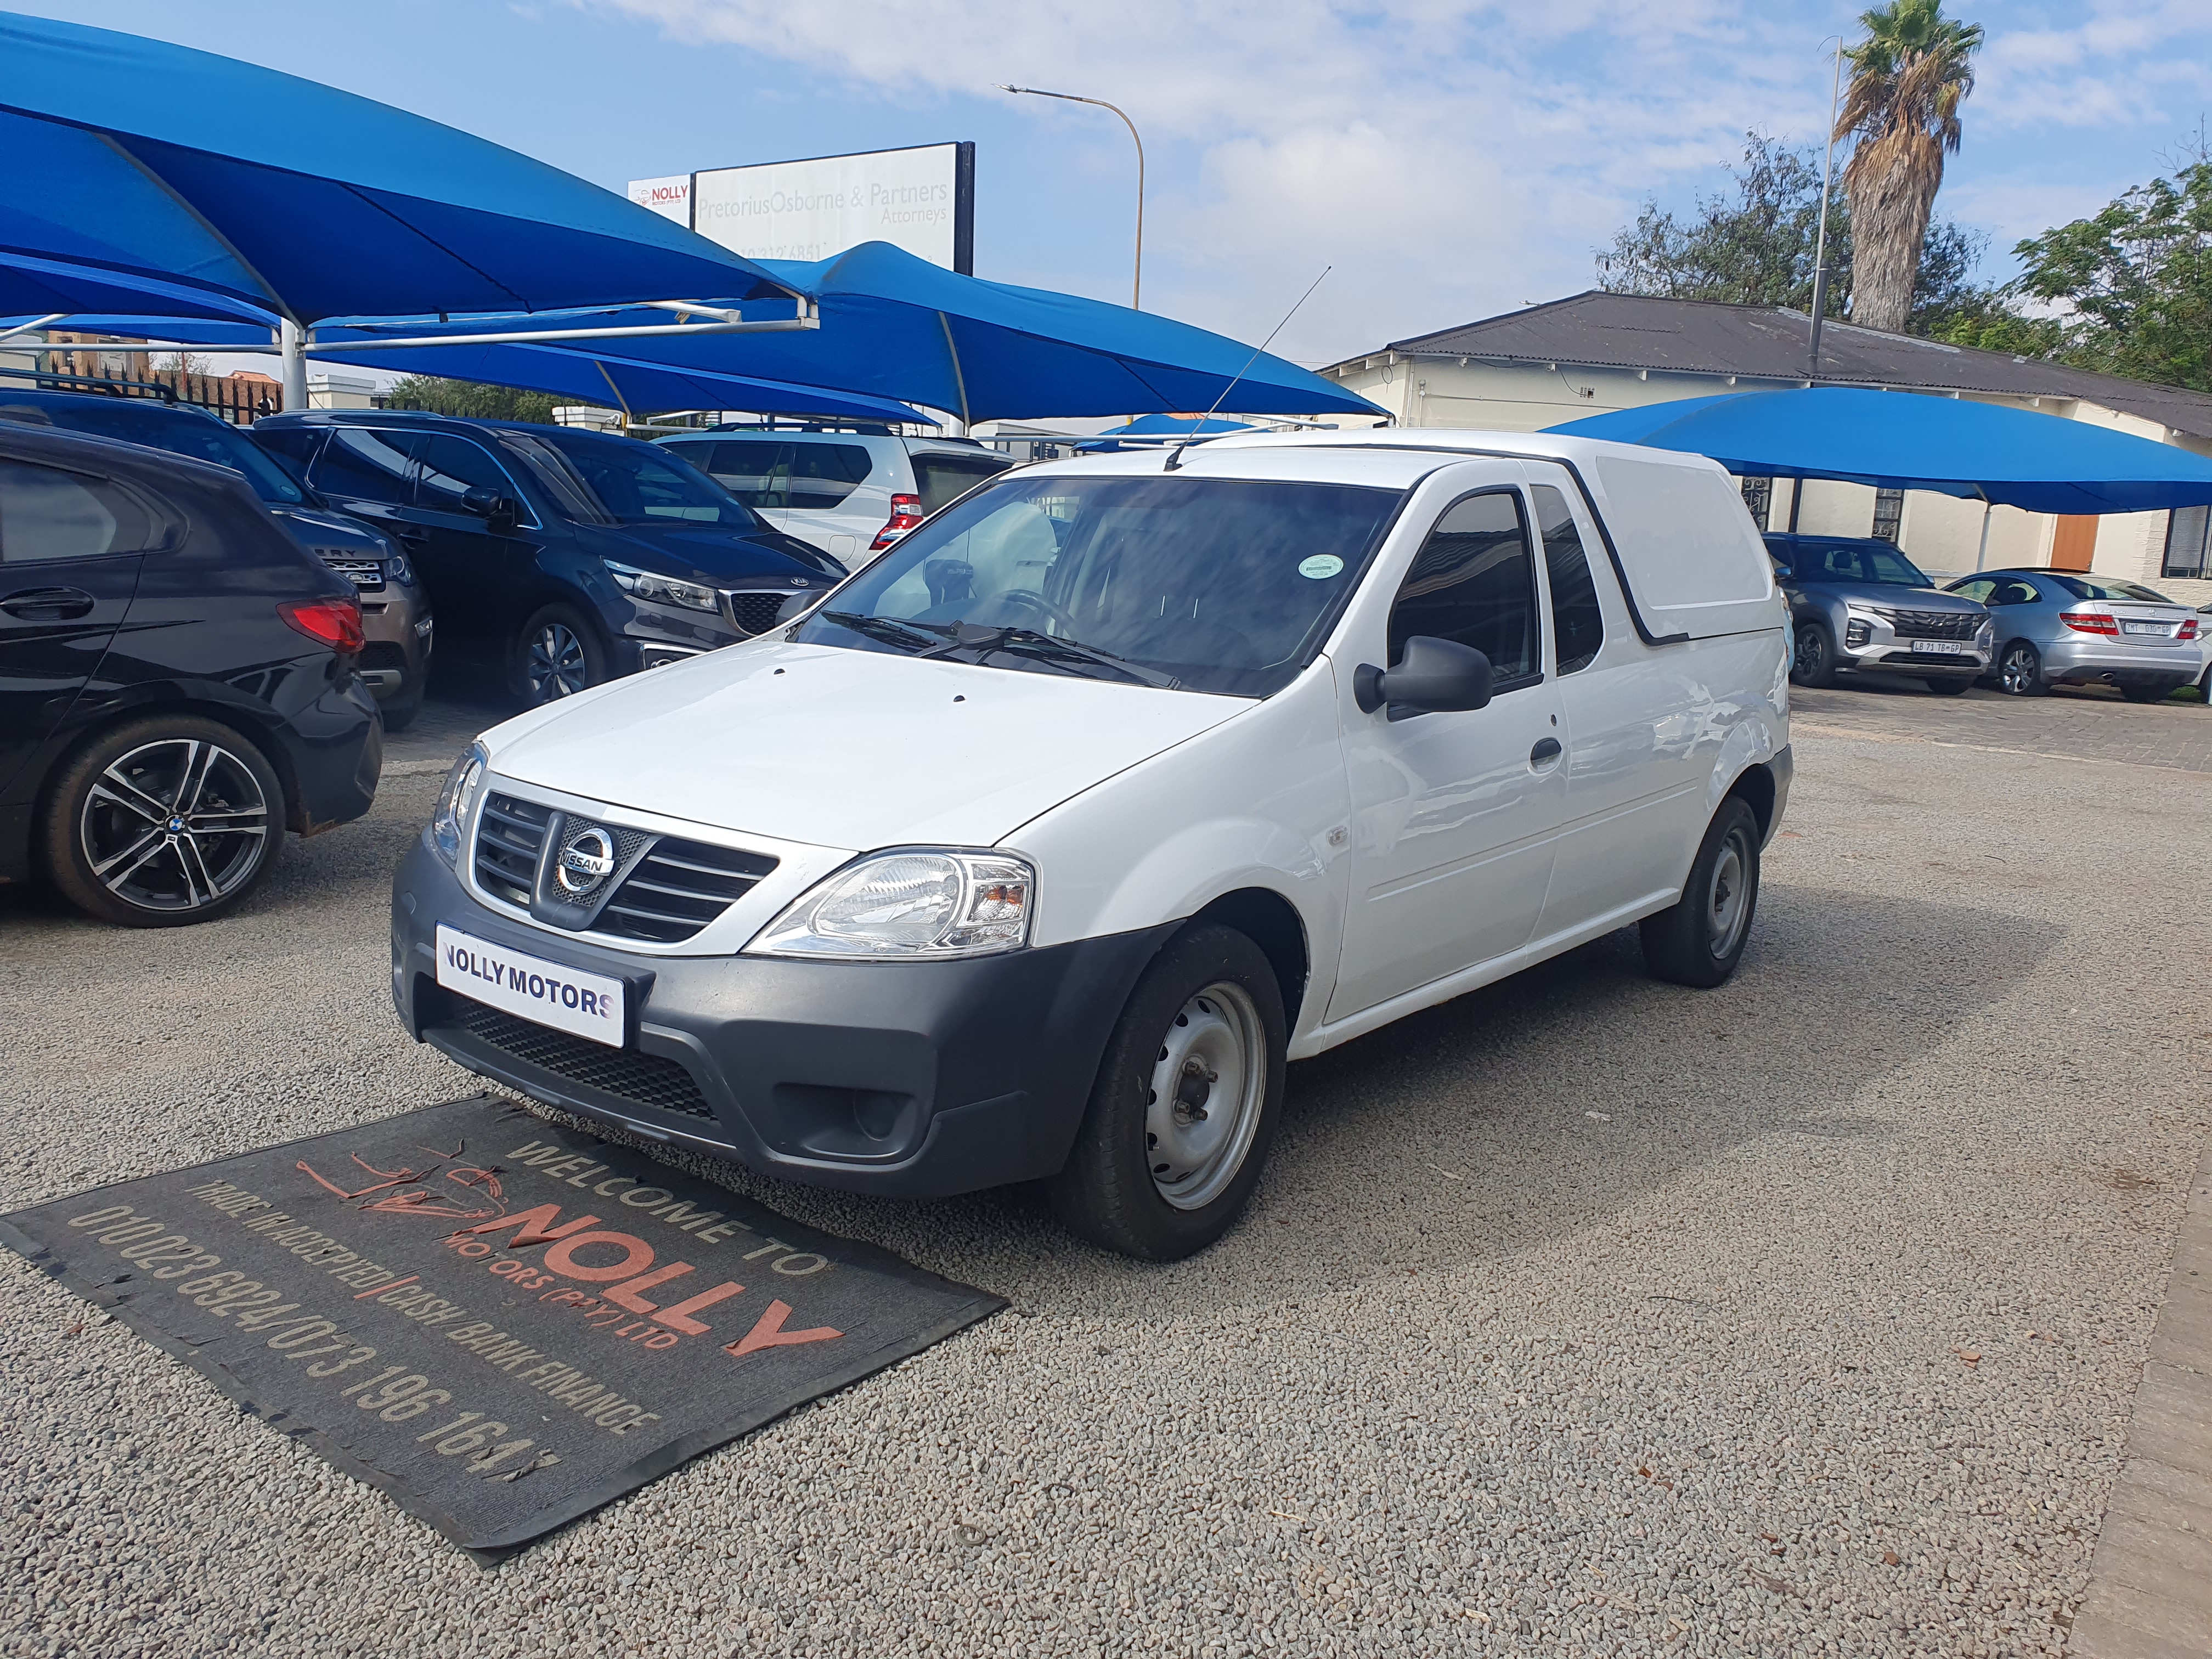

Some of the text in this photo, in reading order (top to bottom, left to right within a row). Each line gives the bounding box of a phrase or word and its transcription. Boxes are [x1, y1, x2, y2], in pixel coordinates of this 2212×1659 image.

[652, 185, 689, 201] NOLLY
[851, 185, 864, 207] &
[871, 183, 947, 206] Partners
[881, 207, 946, 225] Attorneys
[1915, 642, 1923, 651] LB
[1927, 643, 1934, 651] 71
[1937, 644, 1945, 652] TB
[560, 852, 603, 871] NISSAN
[443, 941, 615, 1019] NOLLY MOTORS
[505, 1141, 828, 1276] WELCOME TO
[453, 1203, 845, 1357] NOLLY
[184, 1179, 273, 1218] TRADE
[242, 1211, 296, 1232] IN
[515, 1360, 662, 1435] FINANCE
[614, 1321, 679, 1348] LTD
[341, 1365, 452, 1422] 196
